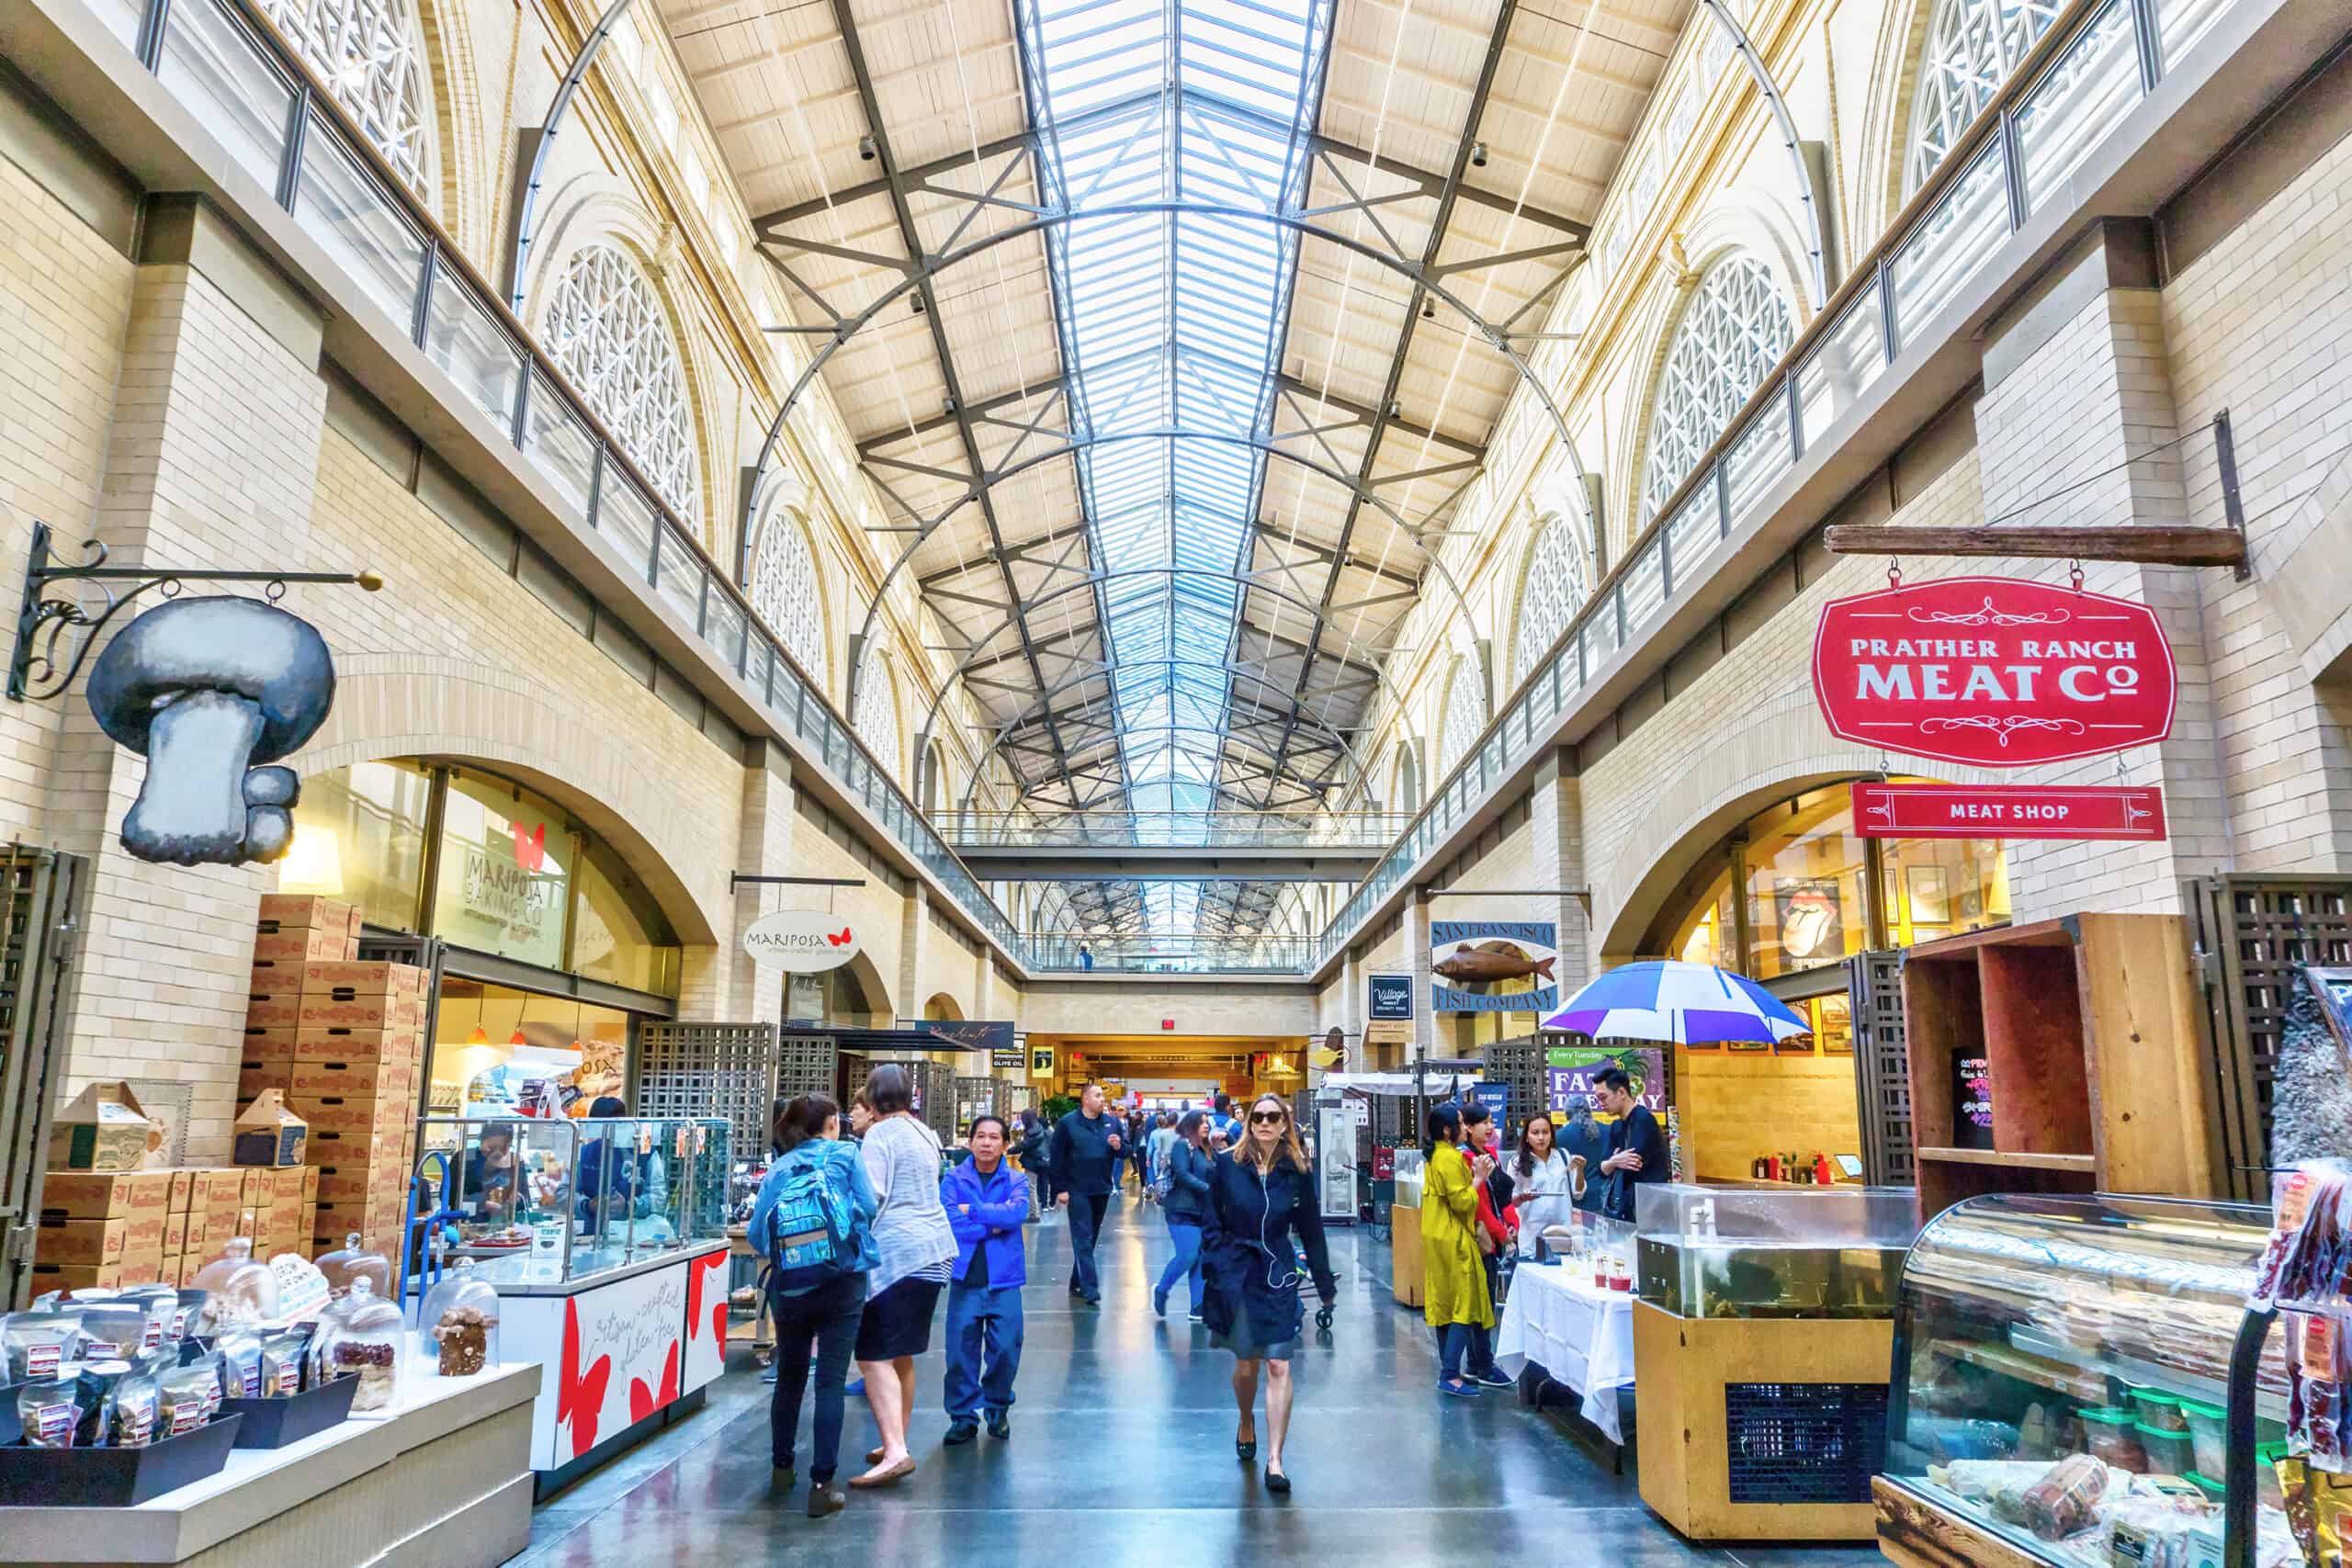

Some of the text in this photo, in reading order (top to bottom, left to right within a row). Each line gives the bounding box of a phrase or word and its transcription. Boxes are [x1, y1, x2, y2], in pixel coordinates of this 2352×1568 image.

[1850, 638, 2138, 660] PRATHER RANCH
[1855, 663, 2042, 702] MEAT
[1950, 804, 2070, 820] MEAT SHOP
[469, 855, 543, 905] MARIPOSA
[746, 932, 826, 947] MARIPOSA
[1433, 923, 1555, 944] SAN FRANCISCO
[1435, 986, 1553, 1010] FISH COMPANY
[1554, 1051, 1572, 1059] Every
